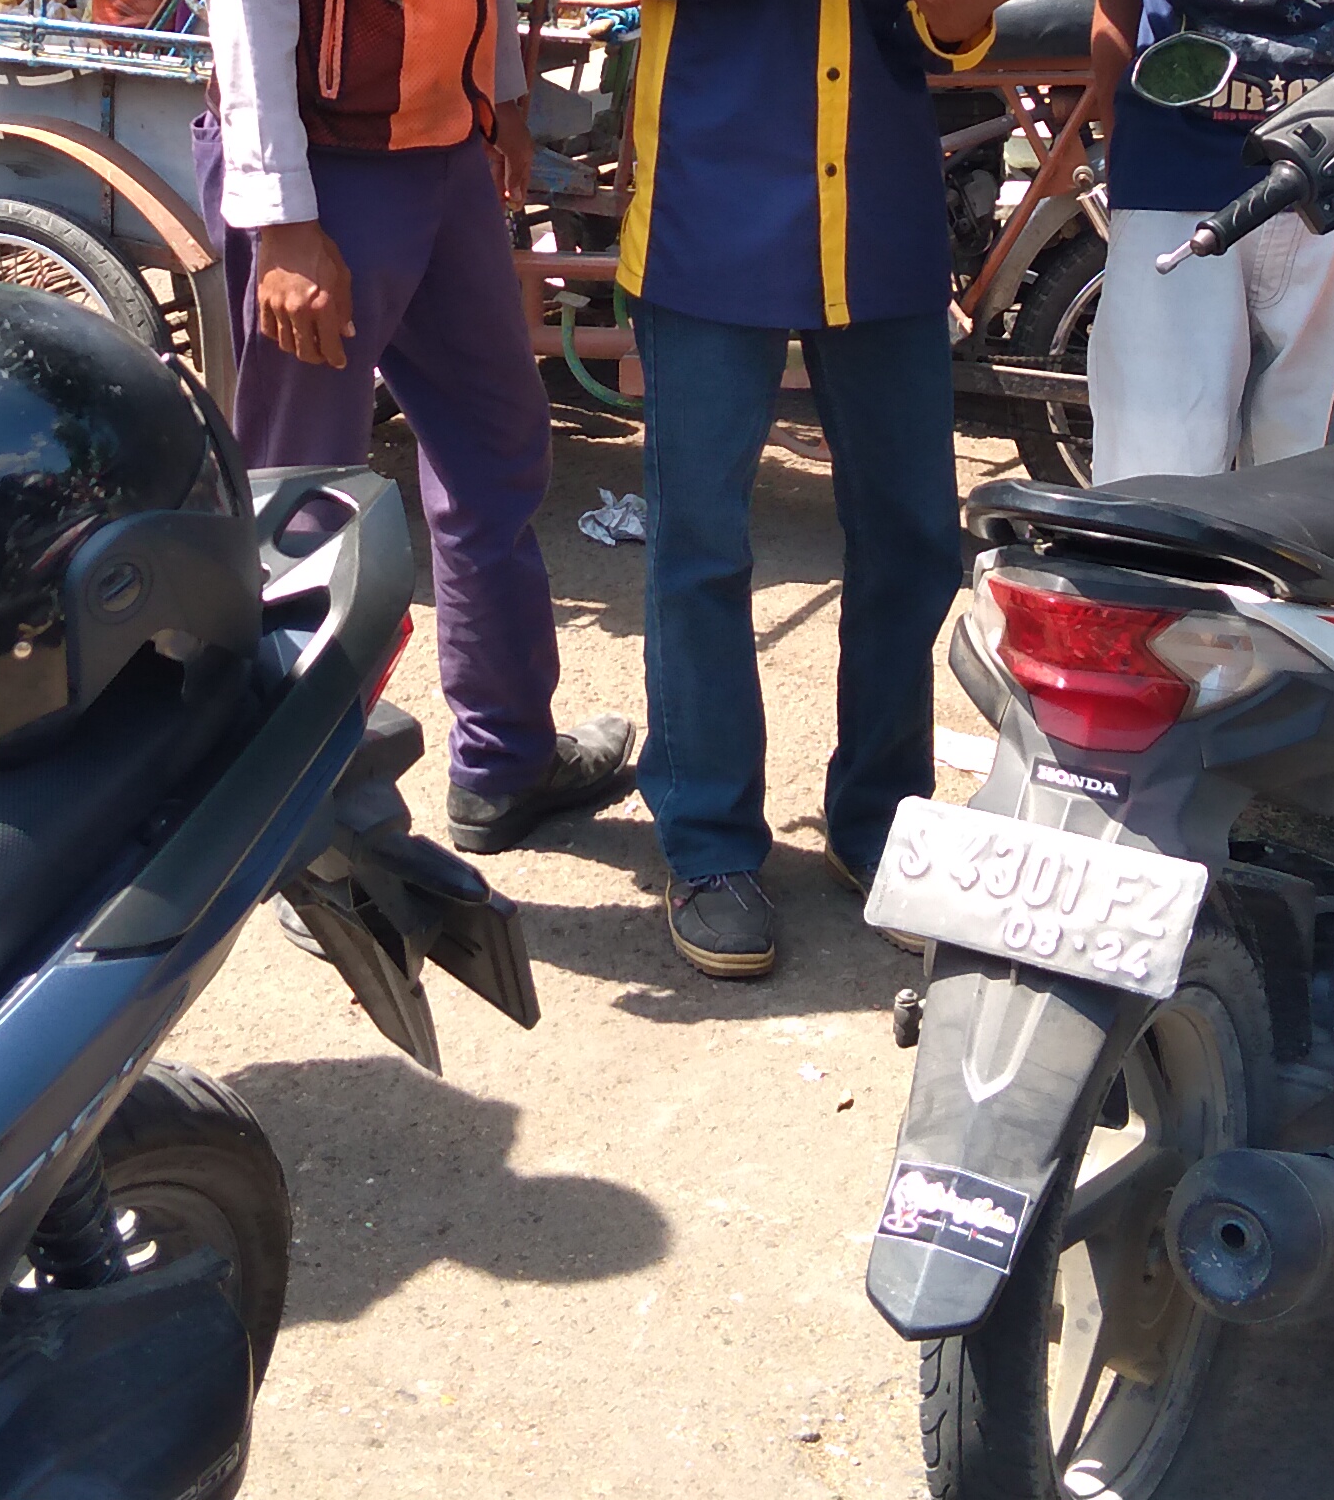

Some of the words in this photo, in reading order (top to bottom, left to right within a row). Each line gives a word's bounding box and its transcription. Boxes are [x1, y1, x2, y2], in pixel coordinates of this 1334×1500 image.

[1036, 764, 1120, 797] HONDA
[898, 828, 933, 879] S
[950, 830, 1090, 918] 4301
[1097, 869, 1183, 938] FZ
